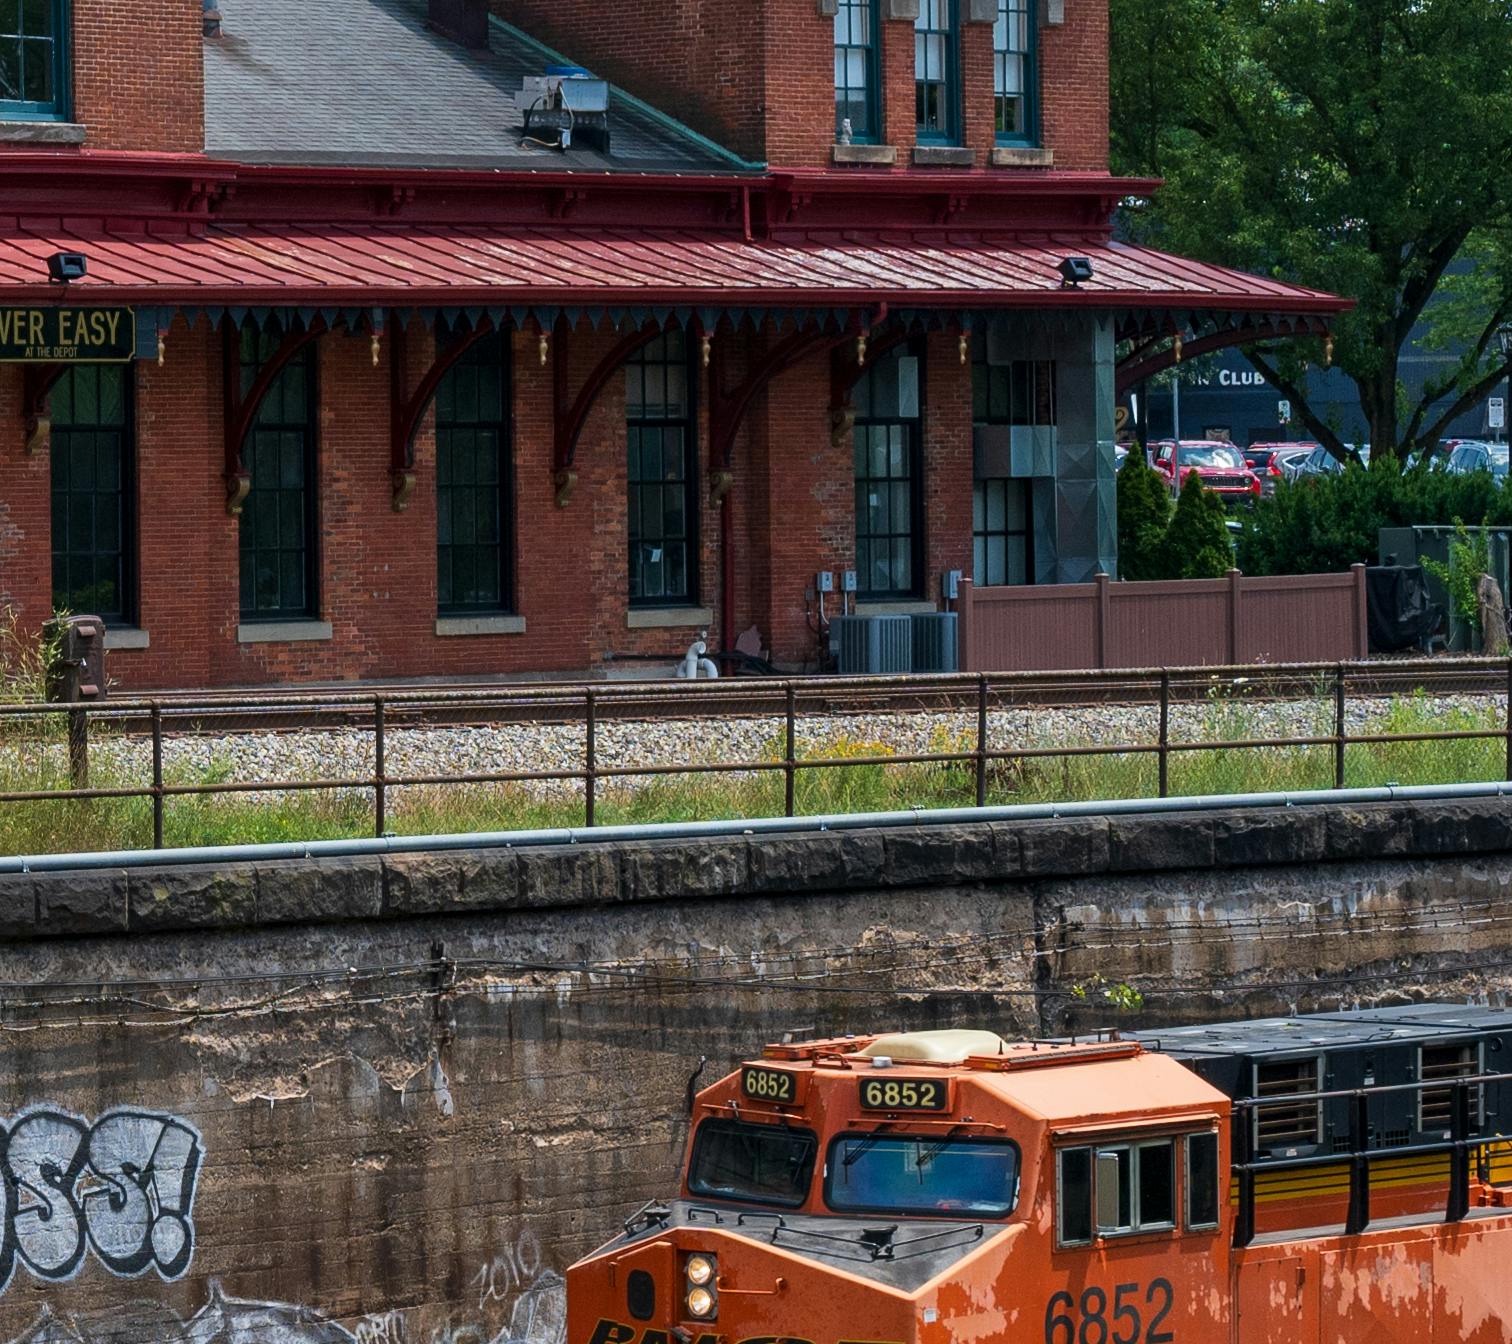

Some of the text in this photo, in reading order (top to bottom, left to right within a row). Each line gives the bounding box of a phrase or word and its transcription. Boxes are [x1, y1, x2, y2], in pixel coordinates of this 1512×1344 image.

[59, 311, 120, 345] EASY
[26, 346, 78, 357] AT THE DEPOT
[1219, 369, 1265, 386] CLUB
[746, 1070, 790, 1098] 6852
[866, 1082, 936, 1106] 6852
